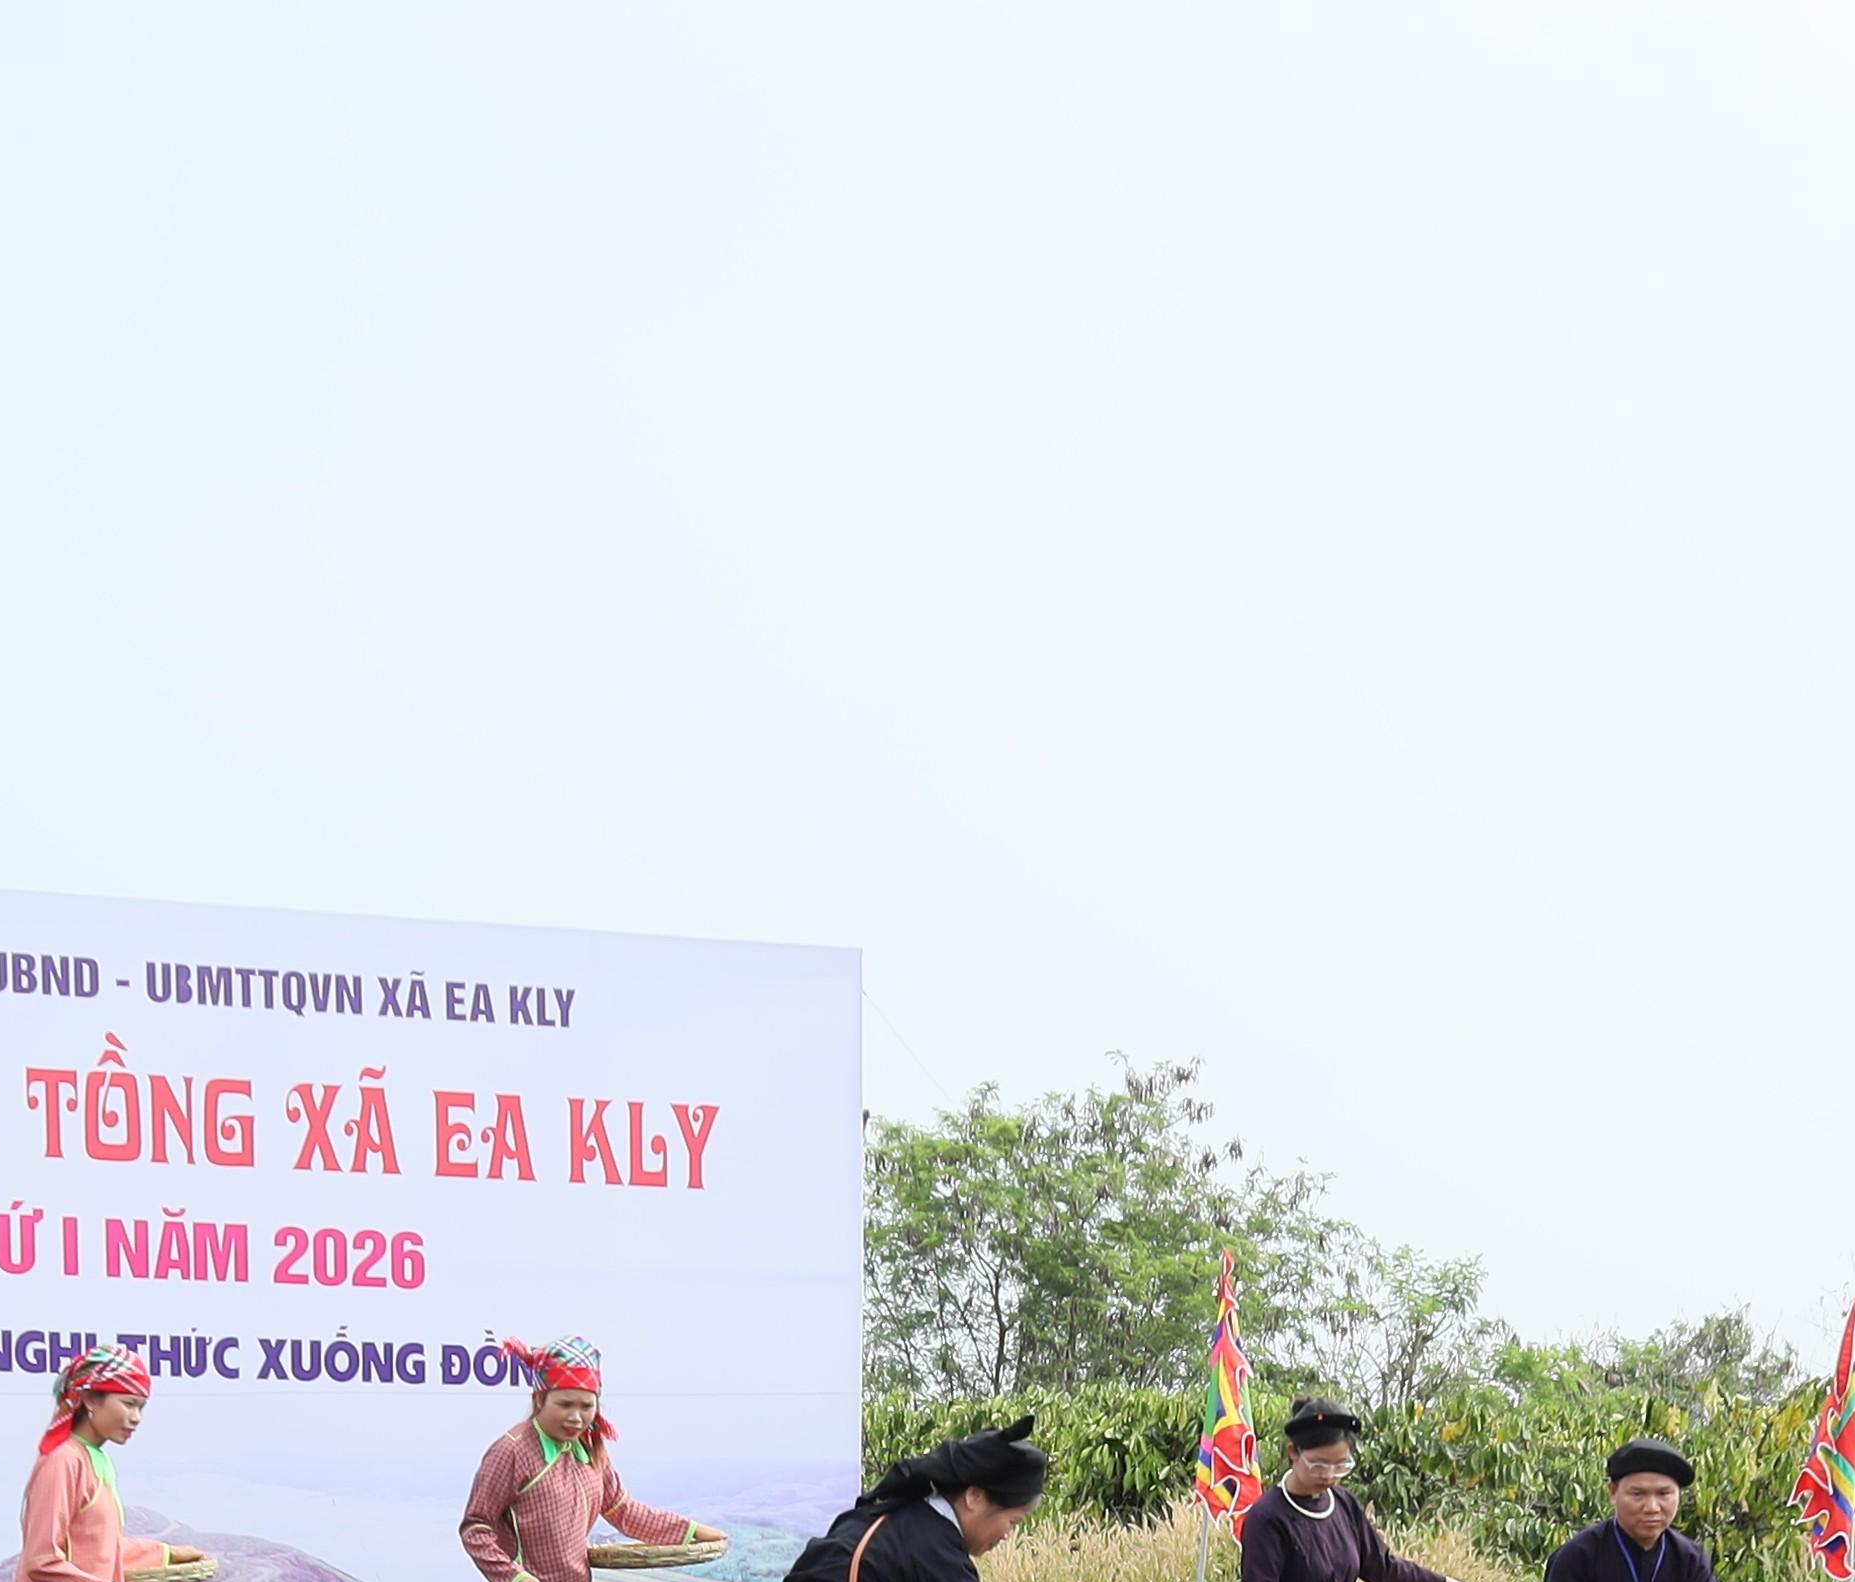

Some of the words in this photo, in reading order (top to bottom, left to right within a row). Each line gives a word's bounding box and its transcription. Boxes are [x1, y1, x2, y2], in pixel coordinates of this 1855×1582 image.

[145, 960, 364, 1017] UBMTTQVN
[377, 970, 432, 1020] XÃ
[444, 980, 497, 1024] EA
[508, 984, 577, 1029] KLY
[25, 1031, 256, 1169] TỒNG
[284, 1064, 403, 1176] XÃ
[432, 1089, 538, 1183] EA
[566, 1097, 721, 1191] KLY
[61, 1215, 80, 1278] I
[104, 1206, 250, 1284] NĂM
[272, 1225, 427, 1291] 2026
[255, 1324, 427, 1386] XUỐNG
